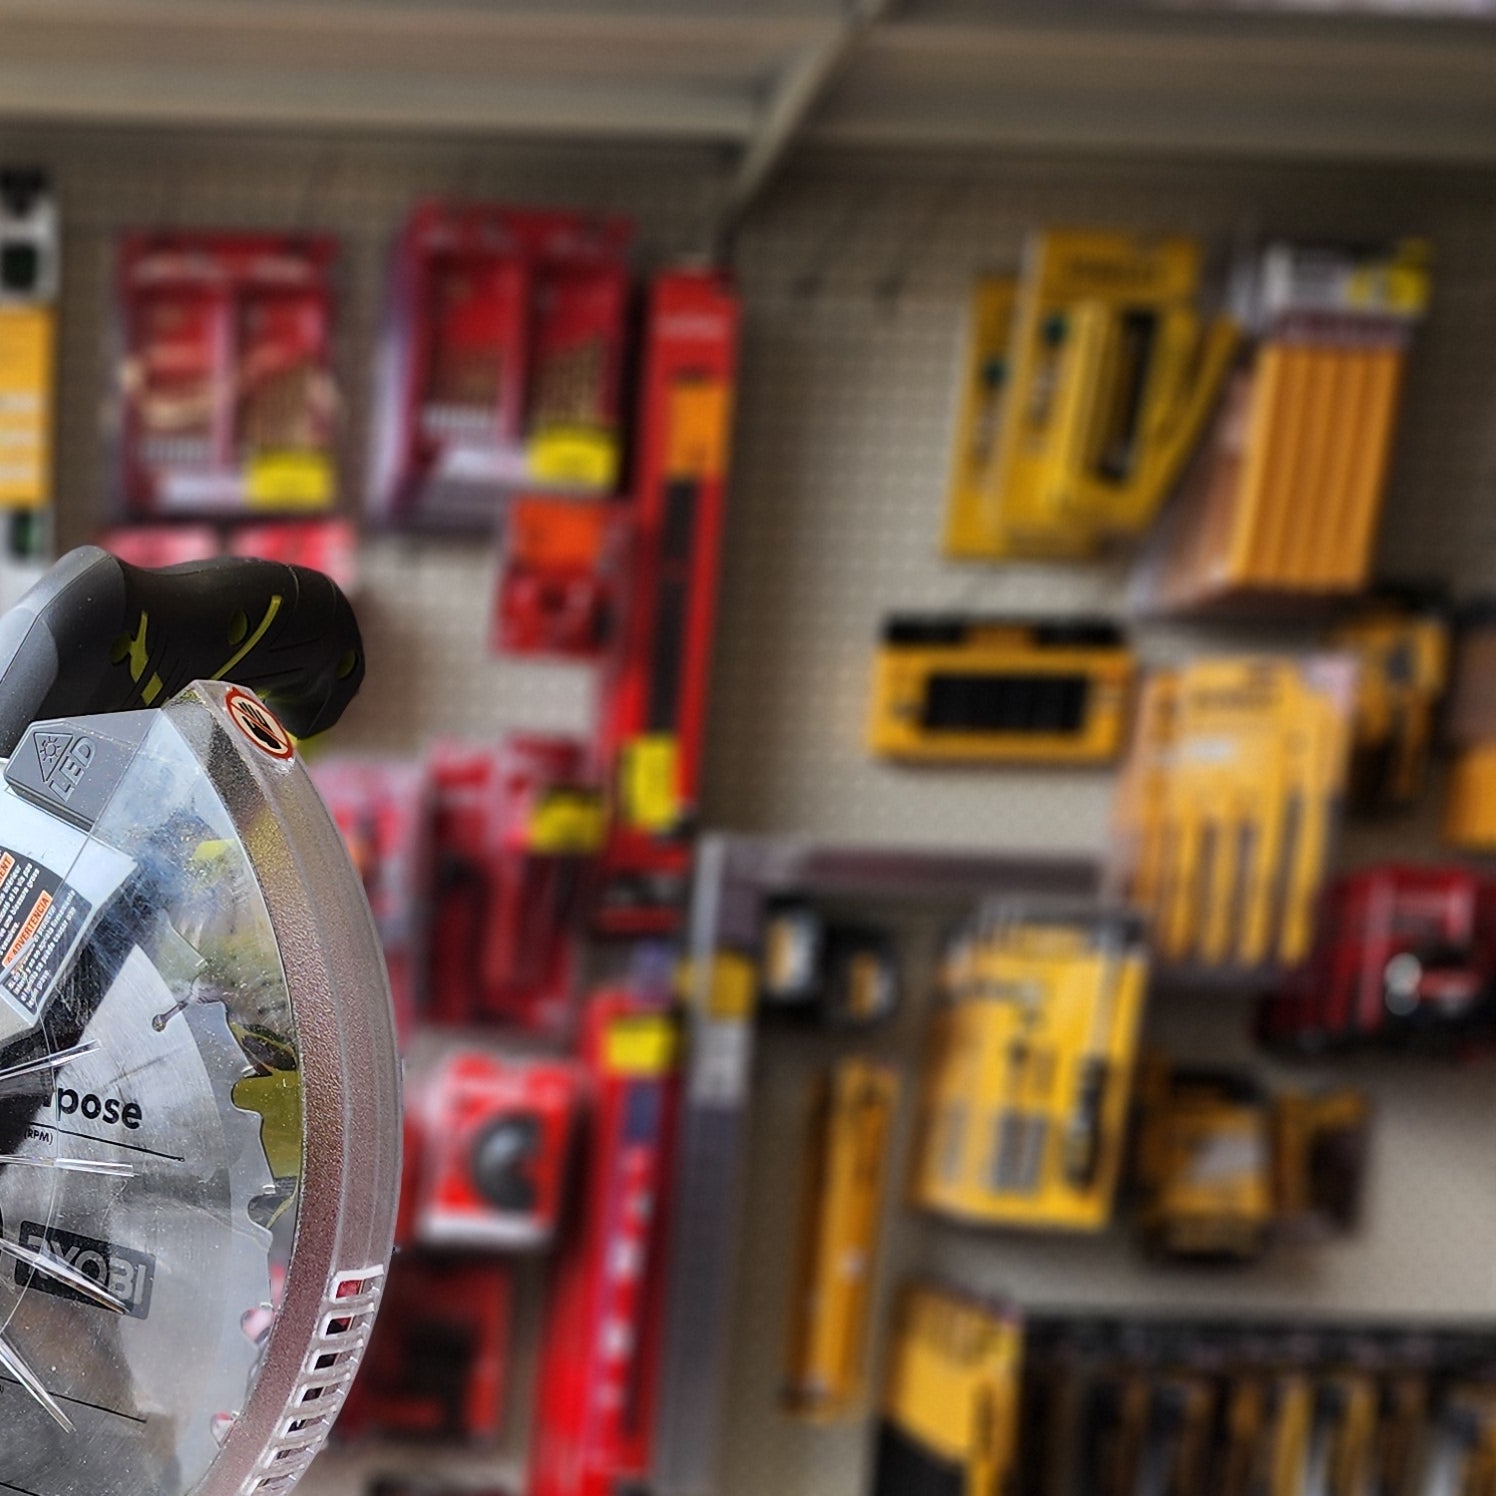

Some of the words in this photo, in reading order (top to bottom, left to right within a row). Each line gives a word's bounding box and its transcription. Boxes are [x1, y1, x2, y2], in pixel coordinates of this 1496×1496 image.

[49, 736, 96, 802] LED
[11, 895, 48, 957] ADVERTENCIA
[43, 1086, 143, 1130] pose
[24, 1127, 54, 1145] (RPM)
